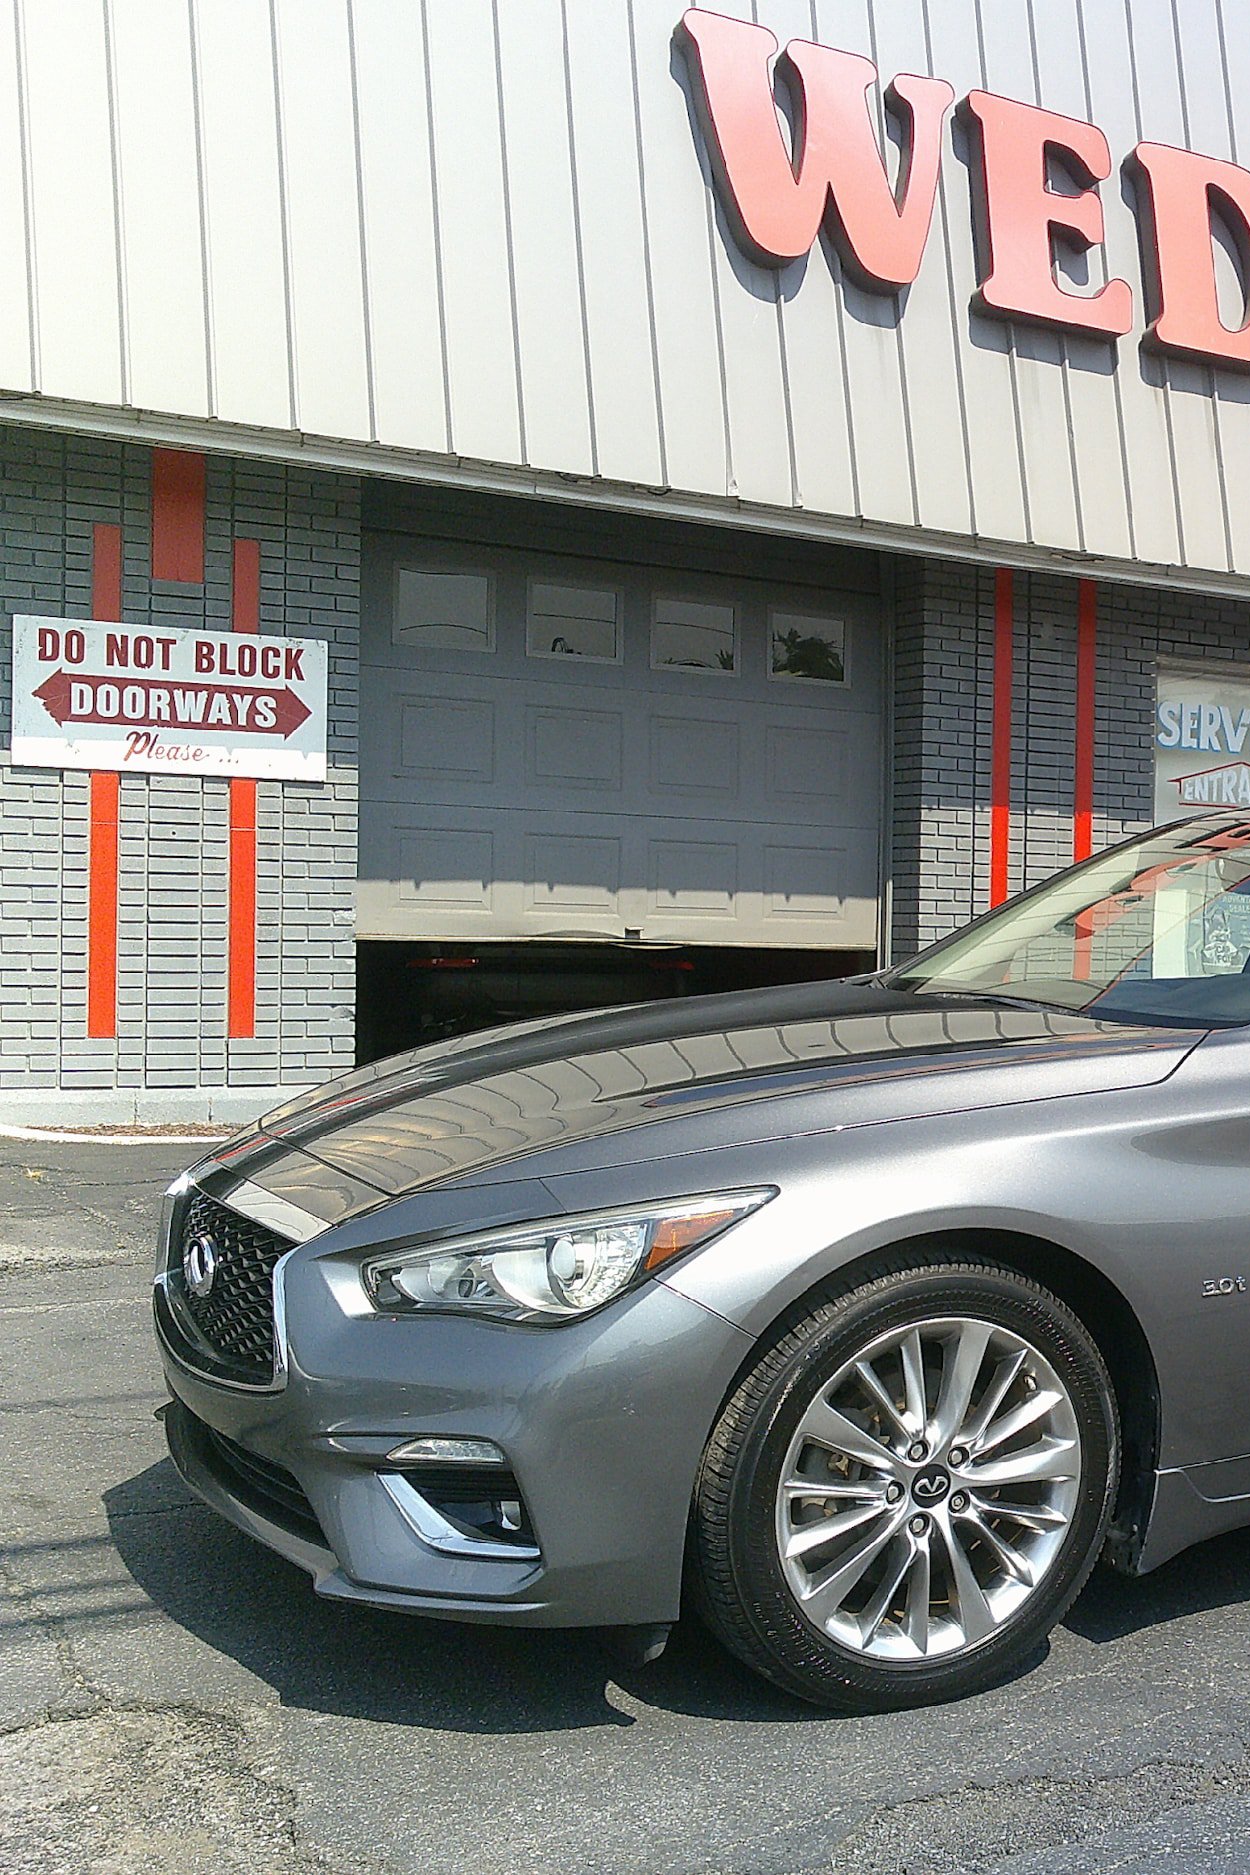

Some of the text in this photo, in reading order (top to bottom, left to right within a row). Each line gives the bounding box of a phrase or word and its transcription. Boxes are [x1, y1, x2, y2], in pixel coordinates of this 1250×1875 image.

[38, 628, 305, 681] DO NOT BLOCK
[70, 682, 277, 728] DOORWAYS
